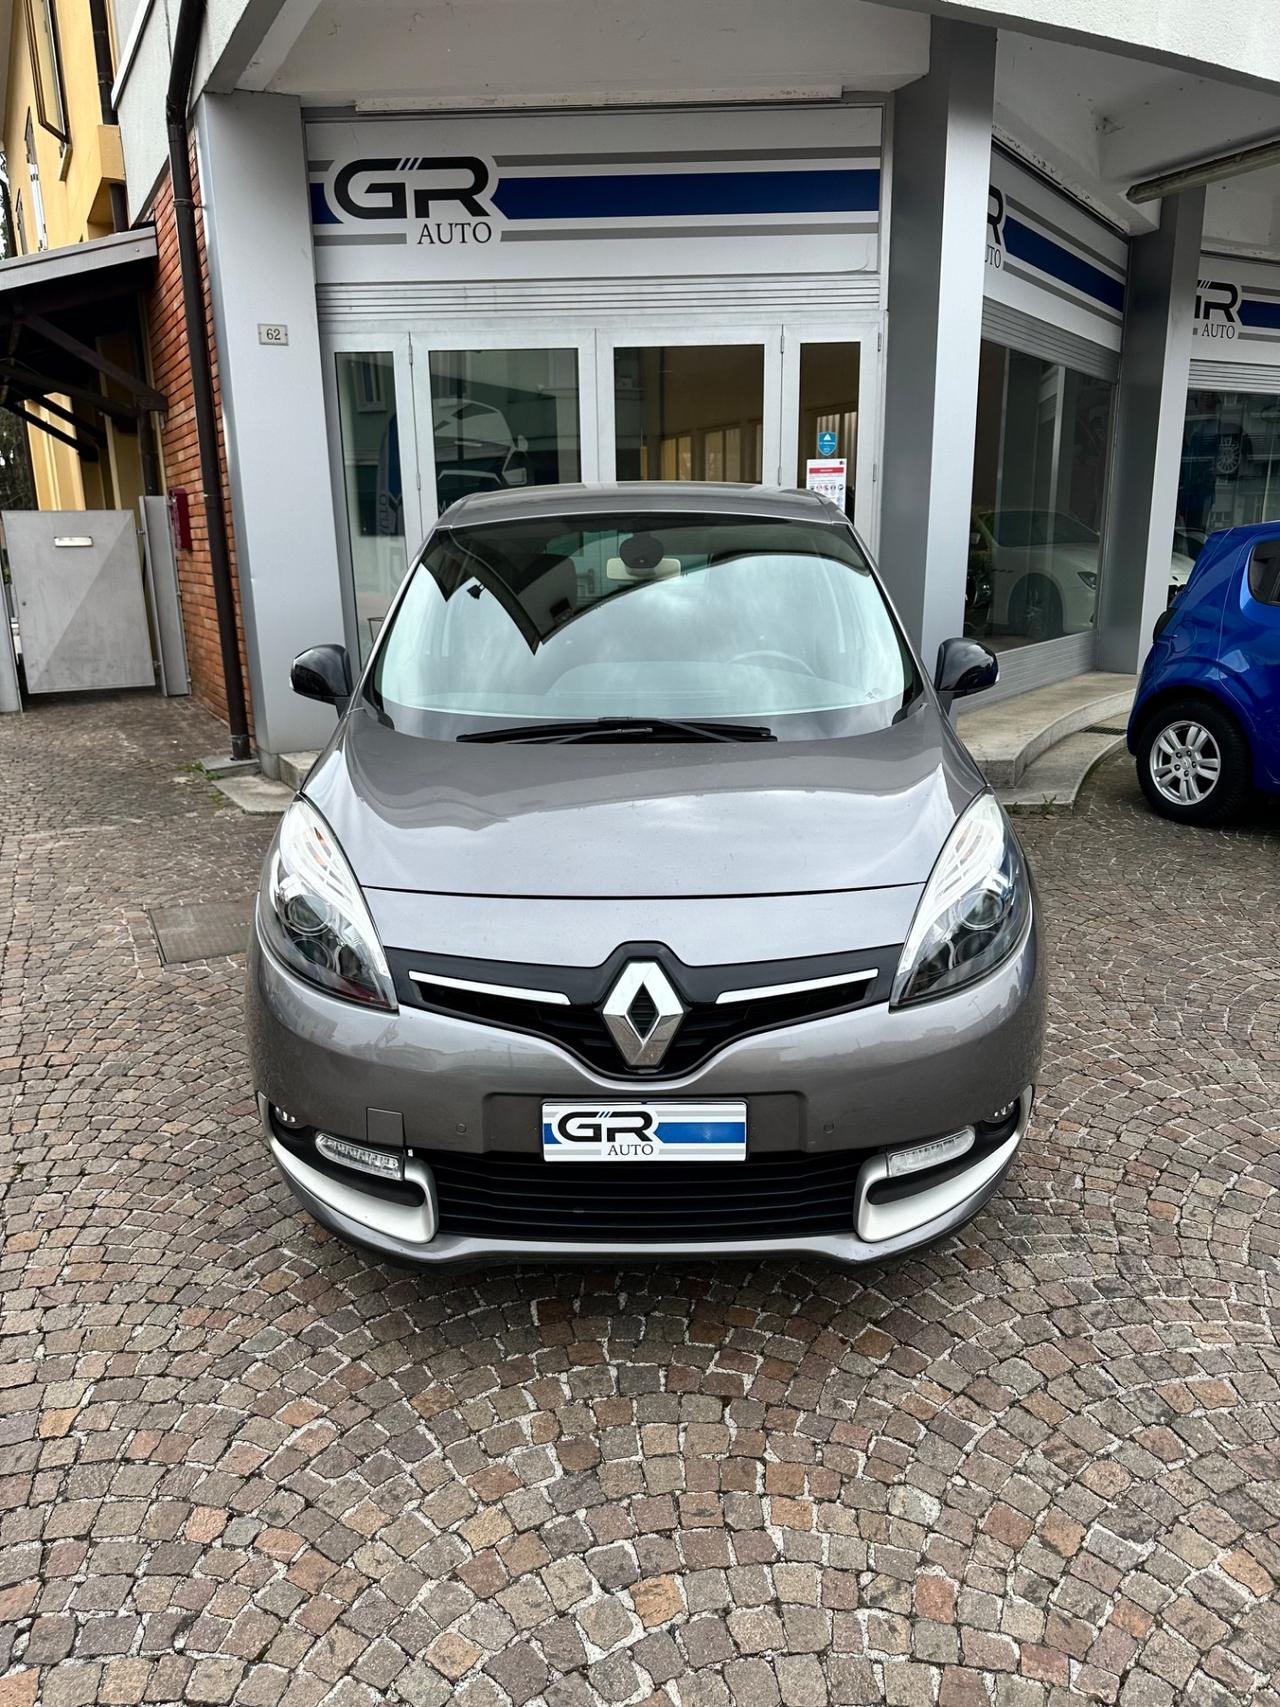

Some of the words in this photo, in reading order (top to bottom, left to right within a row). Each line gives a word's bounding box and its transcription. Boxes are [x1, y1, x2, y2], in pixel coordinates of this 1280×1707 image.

[333, 156, 490, 219] GR
[416, 222, 492, 244] AUTO
[266, 328, 281, 341] 62
[1201, 323, 1235, 339] AUTO
[557, 1110, 653, 1142] GR
[607, 1143, 654, 1156] AUTO
